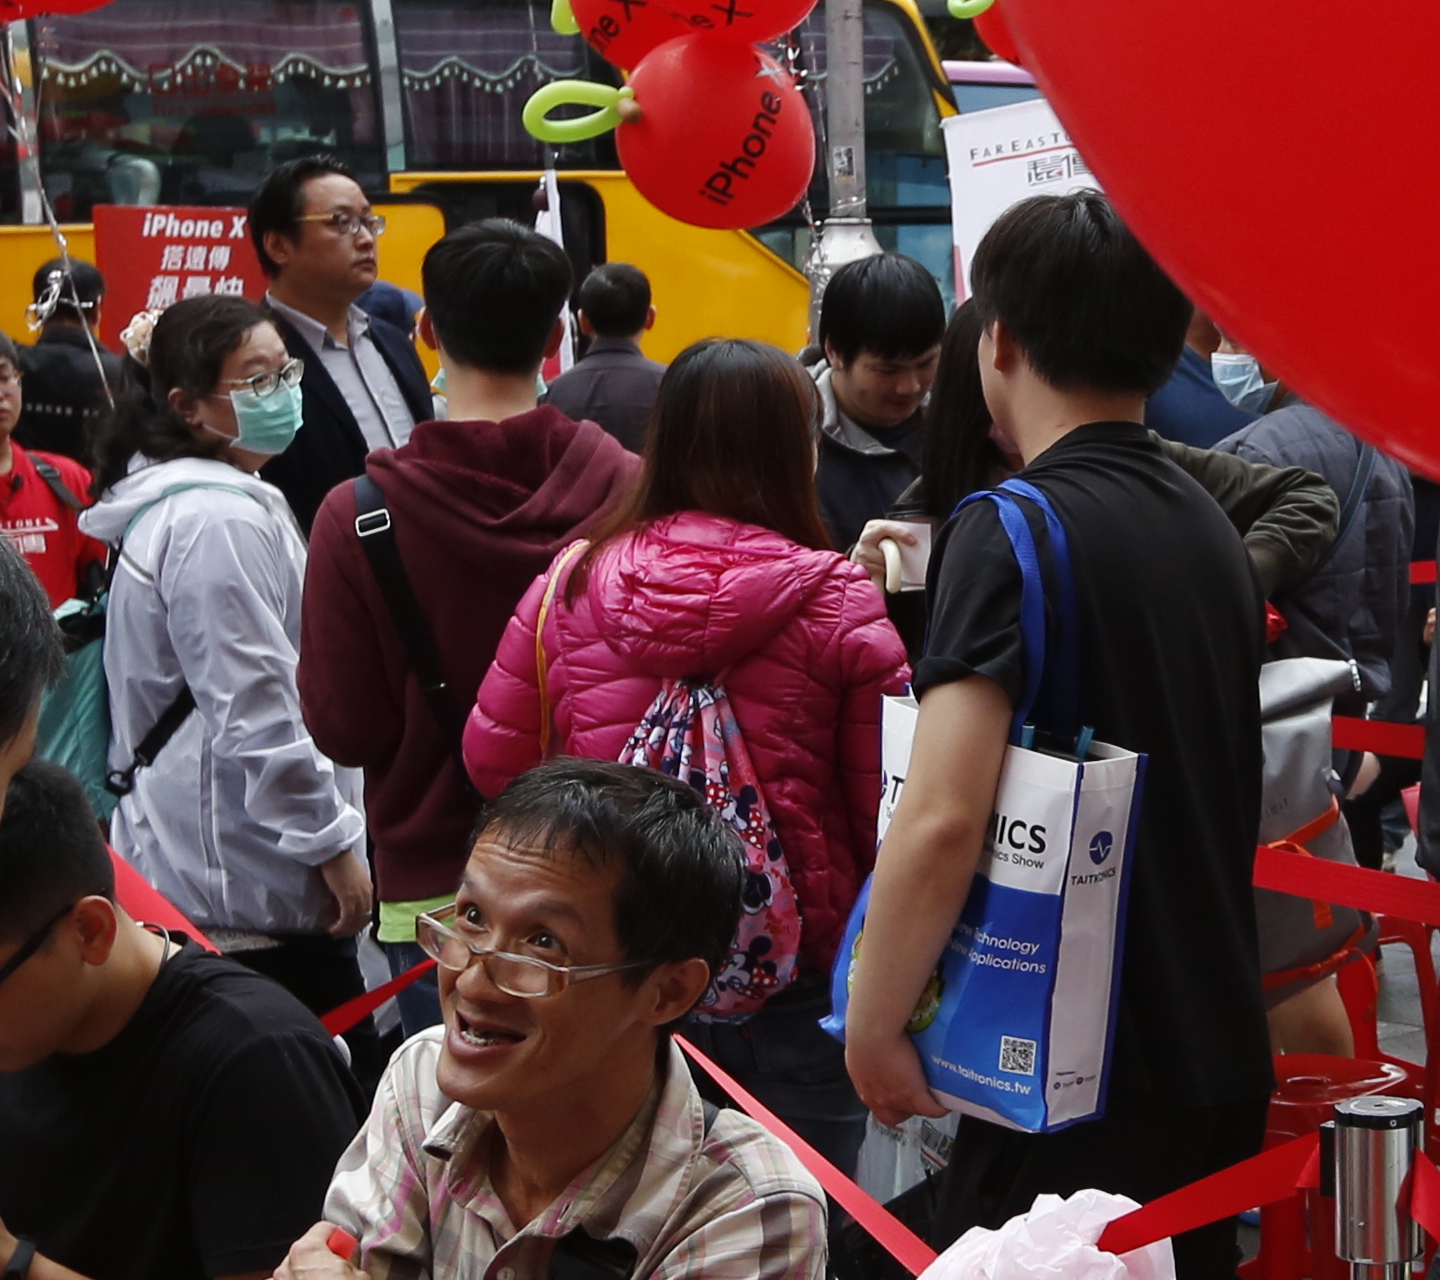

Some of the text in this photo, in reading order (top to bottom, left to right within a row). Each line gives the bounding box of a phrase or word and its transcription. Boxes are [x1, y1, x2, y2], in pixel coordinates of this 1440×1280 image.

[697, 91, 783, 208] iPhone
[142, 212, 248, 239] iPhone X
[1011, 852, 1046, 869] Show
[1071, 866, 1117, 886] TAITRONICS
